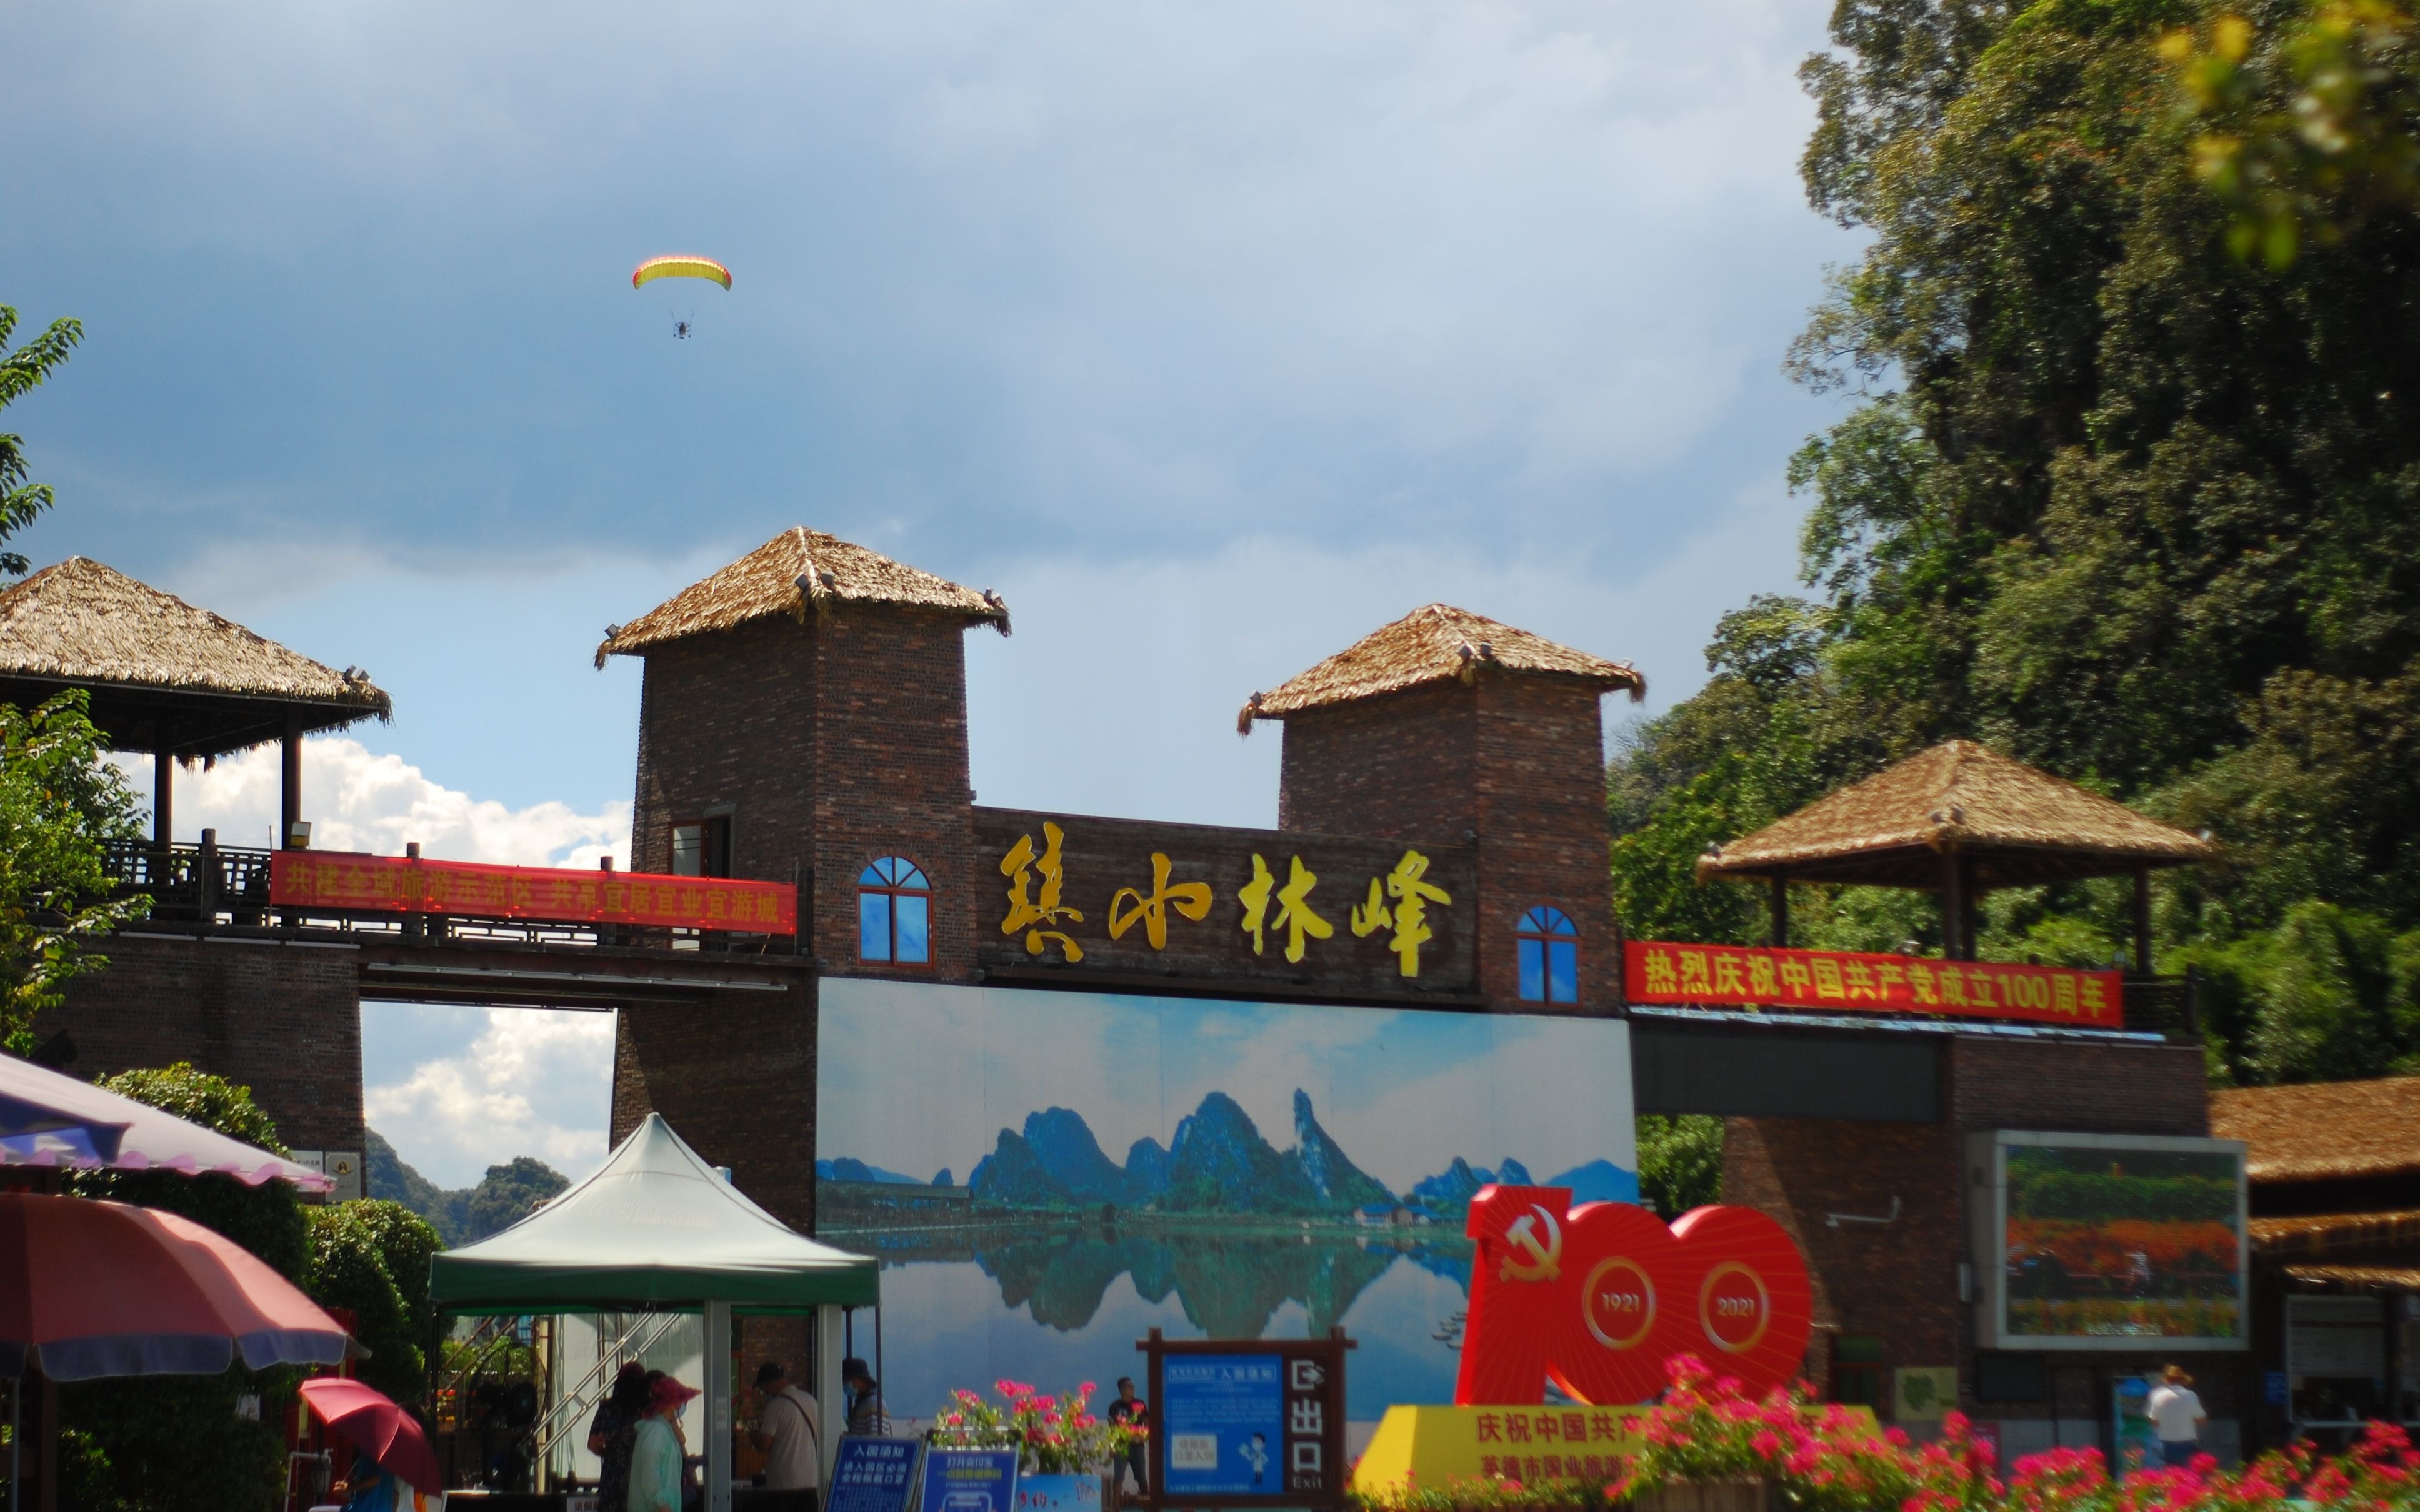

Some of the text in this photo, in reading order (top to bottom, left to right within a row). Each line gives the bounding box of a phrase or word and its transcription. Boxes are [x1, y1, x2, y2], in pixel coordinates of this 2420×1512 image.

[286, 861, 779, 923] 共建全域旅游示范区 共享宜居宜业宜游城
[1645, 948, 2107, 1018] 热烈庆祝中国共产党成立100周年
[1601, 1293, 1639, 1313] 1921
[1716, 1296, 1755, 1317] 2021
[1292, 1398, 1322, 1471] 出口
[854, 1445, 904, 1458] 入园须知
[1293, 1477, 1322, 1490] Exit
